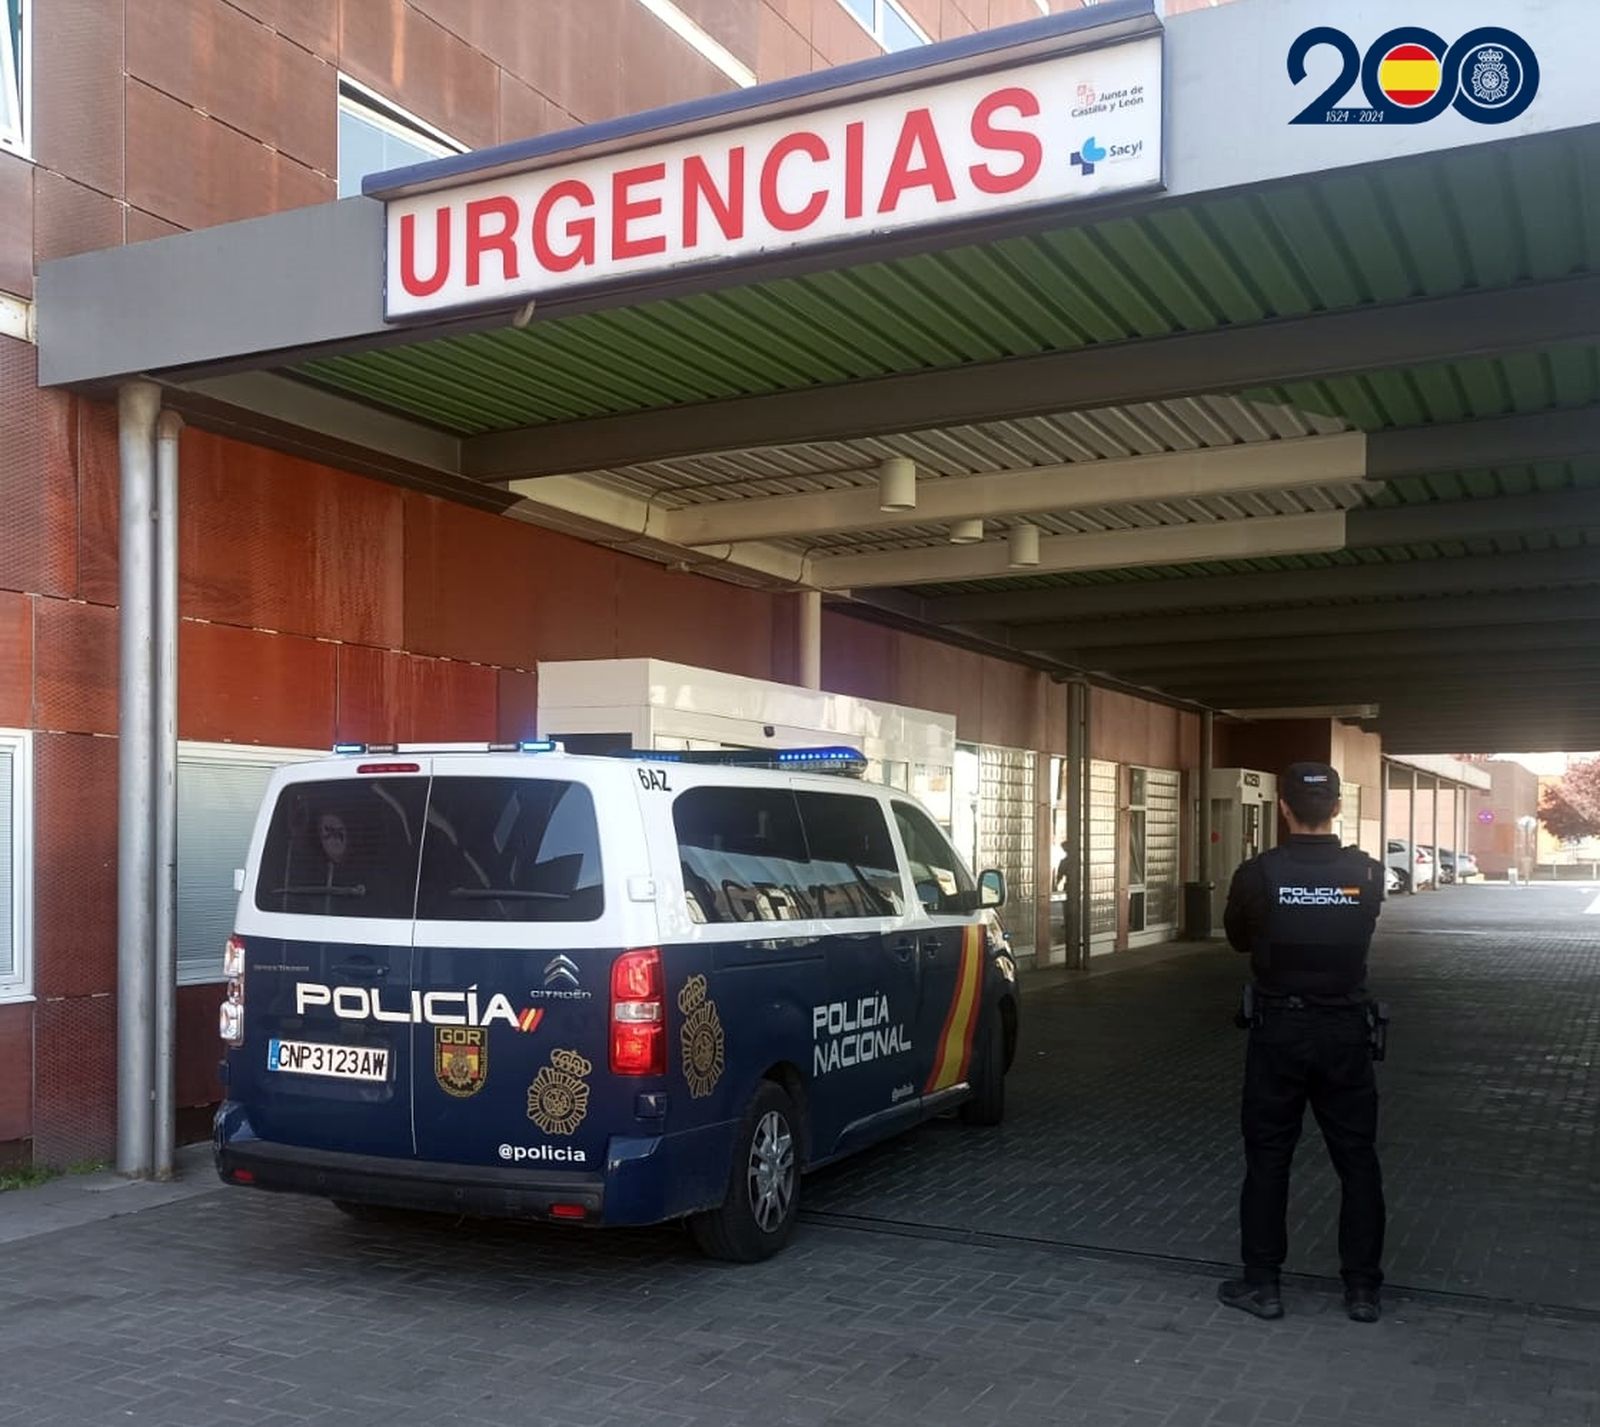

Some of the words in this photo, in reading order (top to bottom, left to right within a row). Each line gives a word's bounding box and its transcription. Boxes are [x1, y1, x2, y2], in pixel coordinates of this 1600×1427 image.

[1099, 89, 1128, 102] Junta
[1130, 85, 1144, 94] de
[1071, 103, 1107, 117] Castilla
[1109, 102, 1117, 112] y
[1119, 96, 1144, 108] León
[1109, 139, 1143, 157] Sacyl
[399, 87, 1043, 298] URGENCIAS
[637, 767, 672, 792] 6AZ
[1279, 896, 1360, 905] NACIONAL
[296, 982, 520, 1028] POLICÍA
[813, 989, 889, 1041] POLICÍA
[440, 1028, 481, 1046] GOR
[278, 1043, 386, 1077] CNP3123AW
[813, 1023, 912, 1078] NACIONAL
[498, 1143, 586, 1162] @policia
